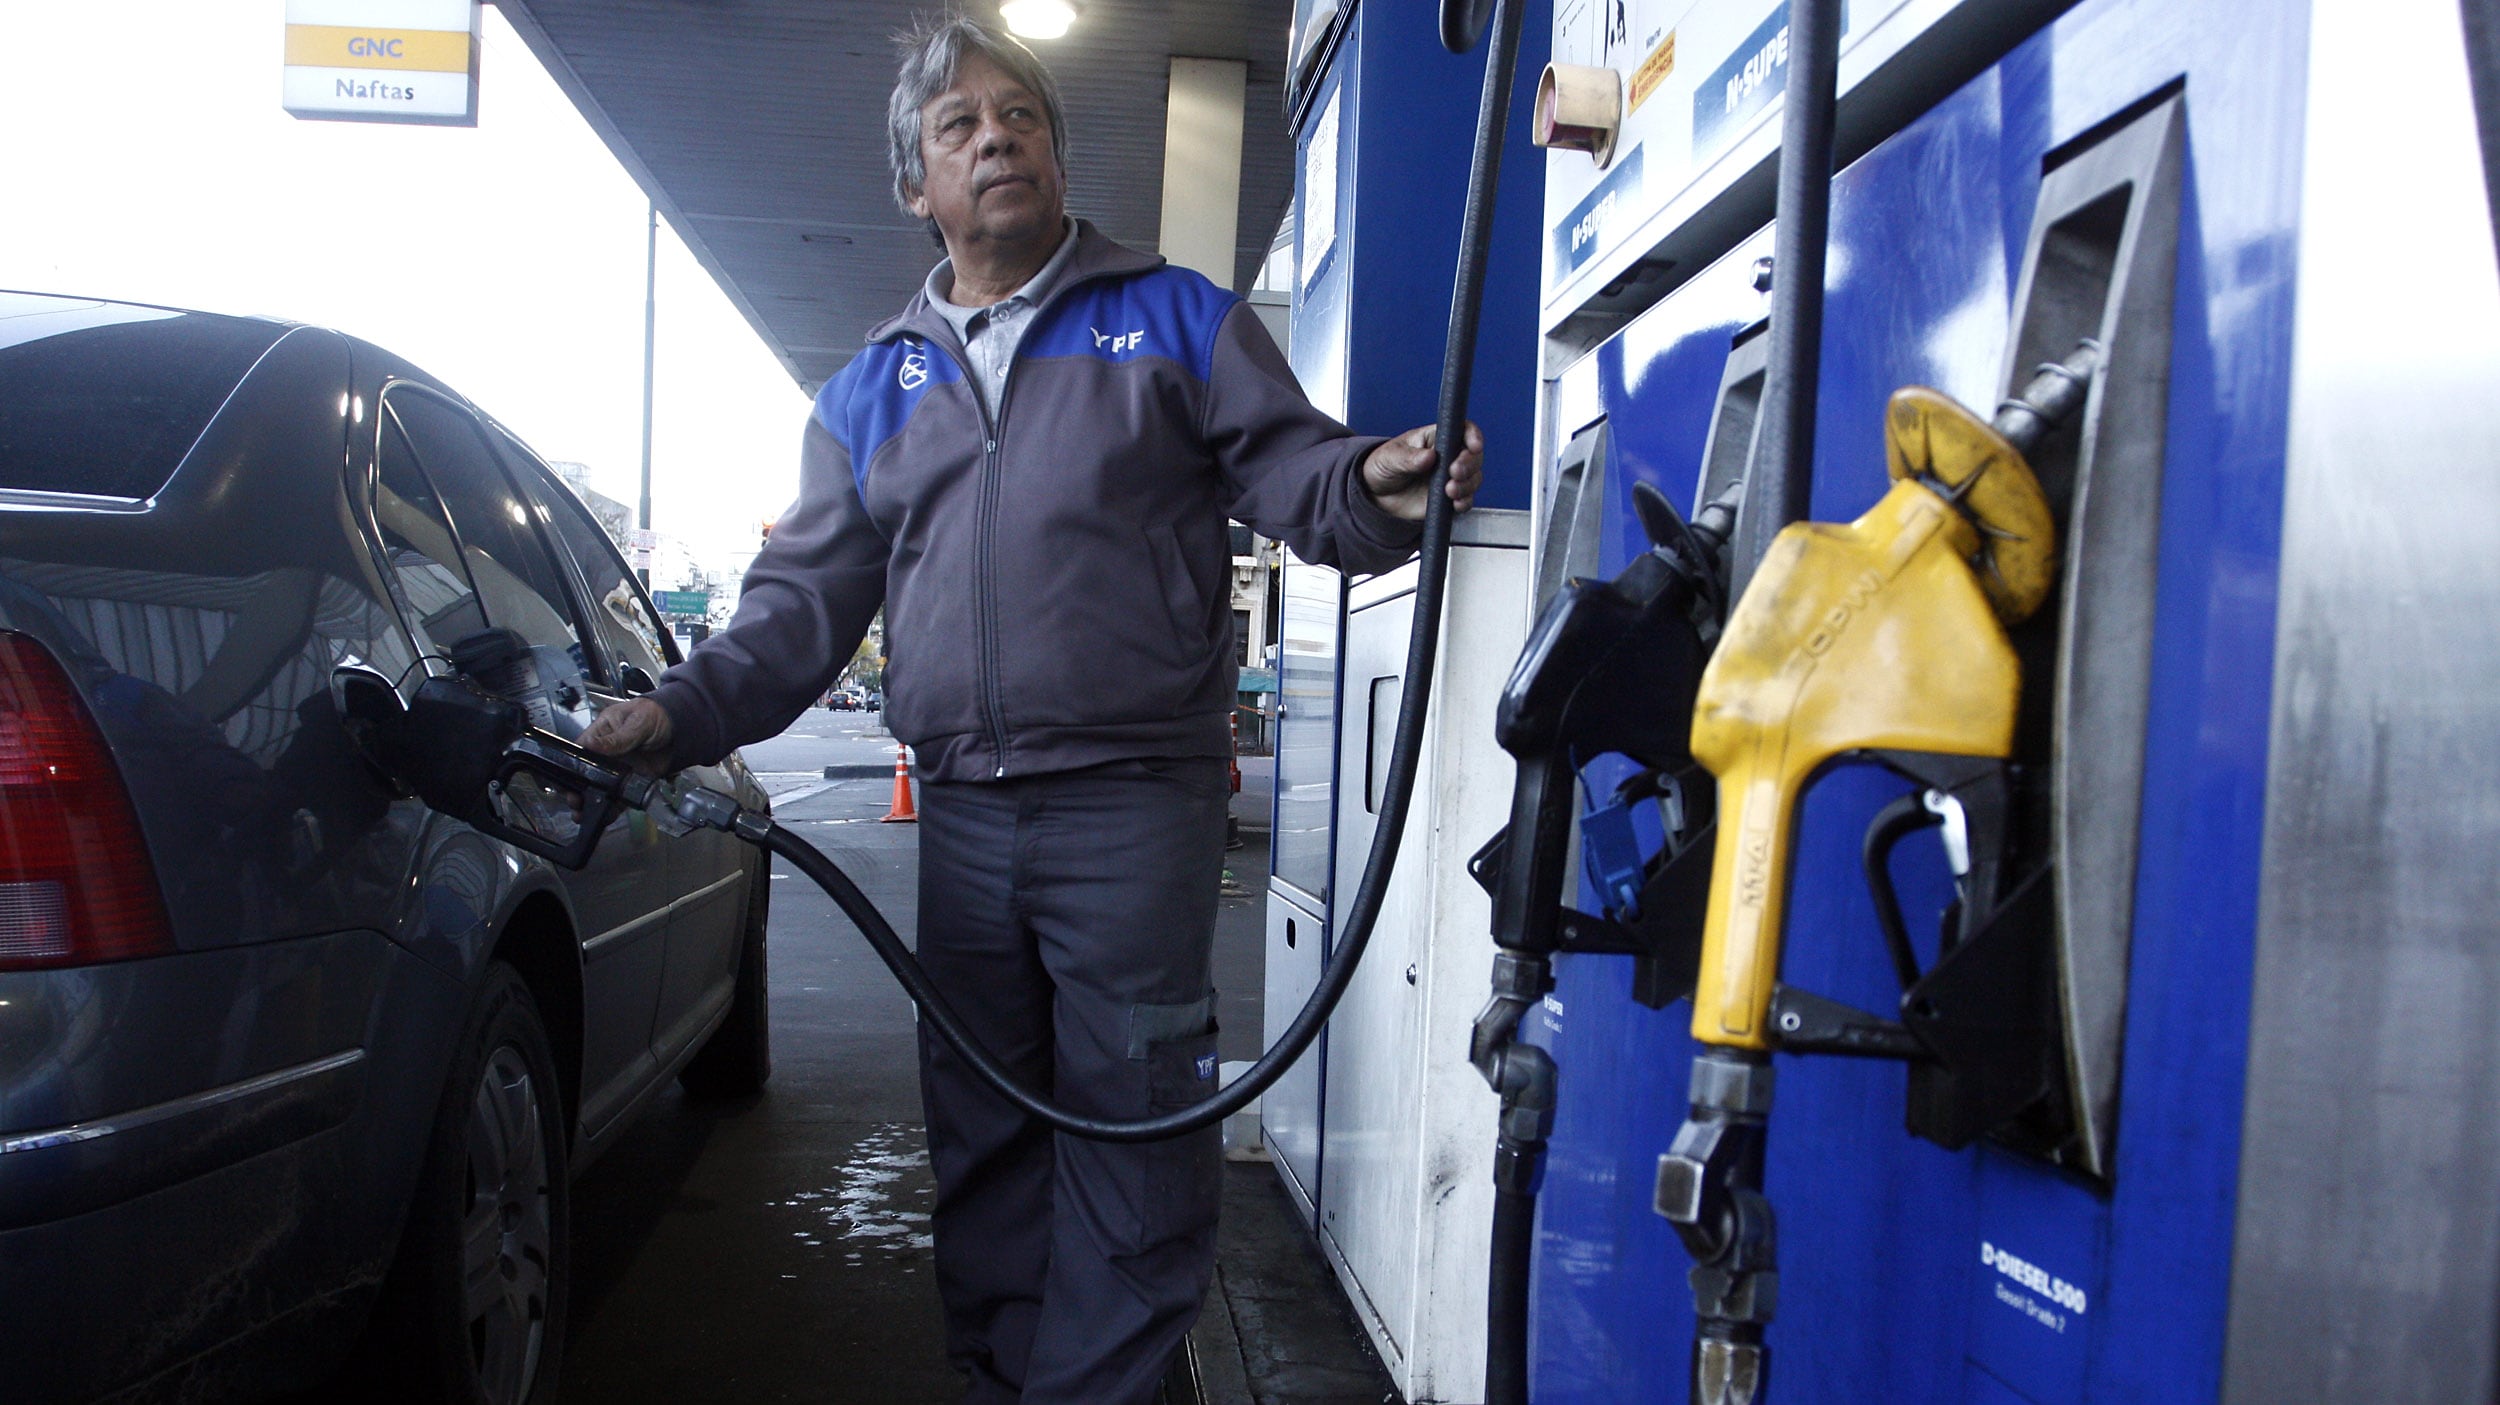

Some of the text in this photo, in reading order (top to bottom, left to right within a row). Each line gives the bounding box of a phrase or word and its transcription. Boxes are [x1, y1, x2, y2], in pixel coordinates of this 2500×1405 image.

[348, 37, 404, 59] GNC
[1638, 53, 1672, 98] EMERGENCIA
[336, 79, 414, 100] Naftas
[1090, 326, 1145, 354] YPF
[1197, 1056, 1216, 1076] YPF
